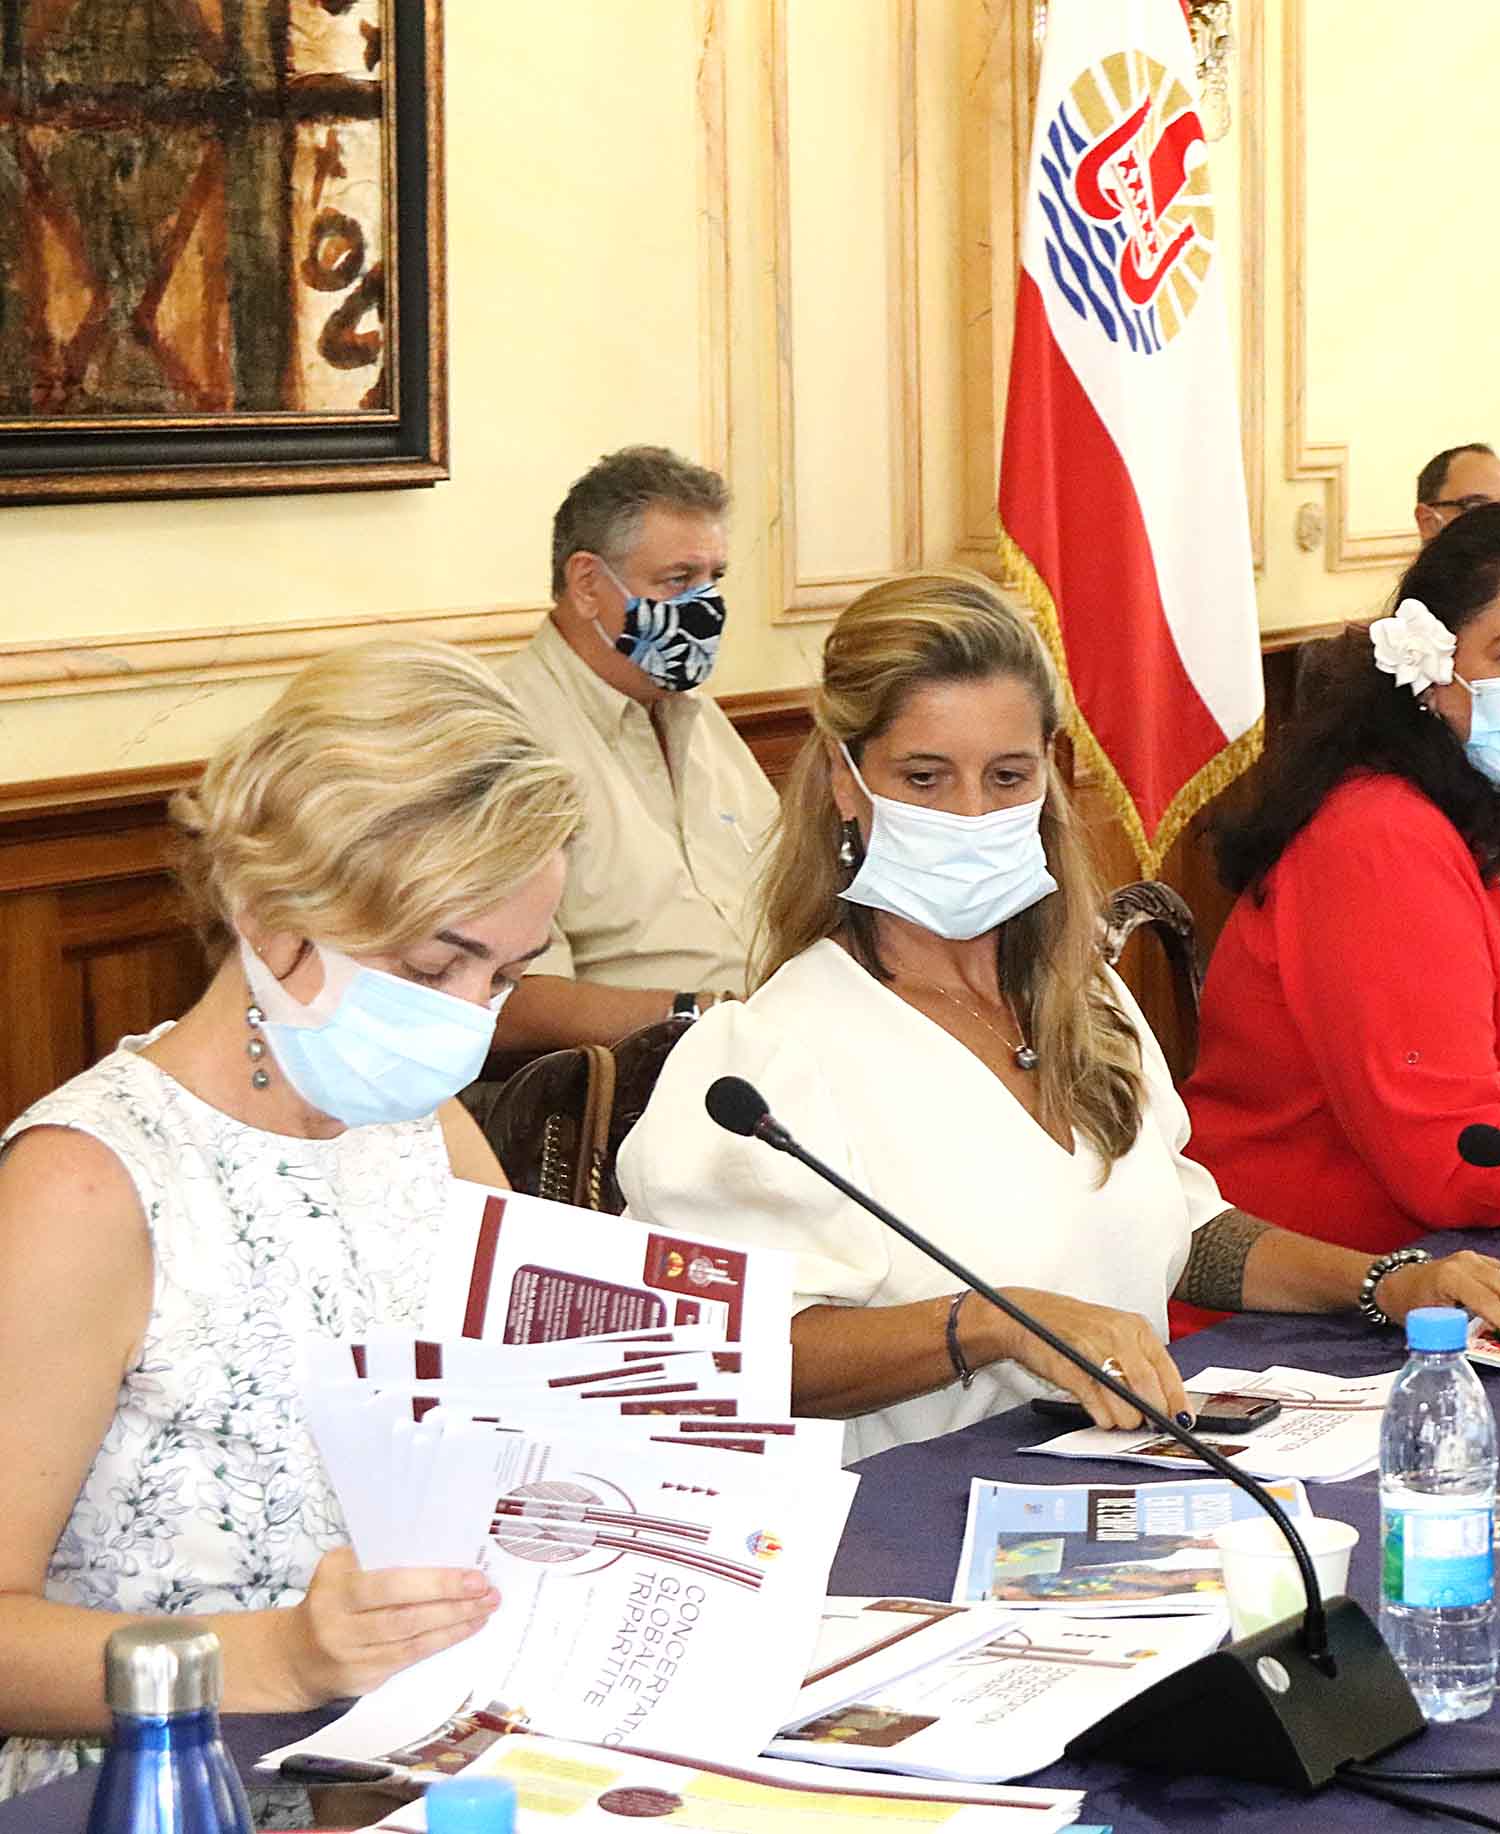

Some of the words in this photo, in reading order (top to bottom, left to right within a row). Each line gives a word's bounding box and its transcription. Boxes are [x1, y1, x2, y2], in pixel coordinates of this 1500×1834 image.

[583, 1571, 657, 1707] TRIPARTITE
[601, 1584, 706, 1746] CONCERTATIO
[619, 1576, 681, 1694] GLOBALE
